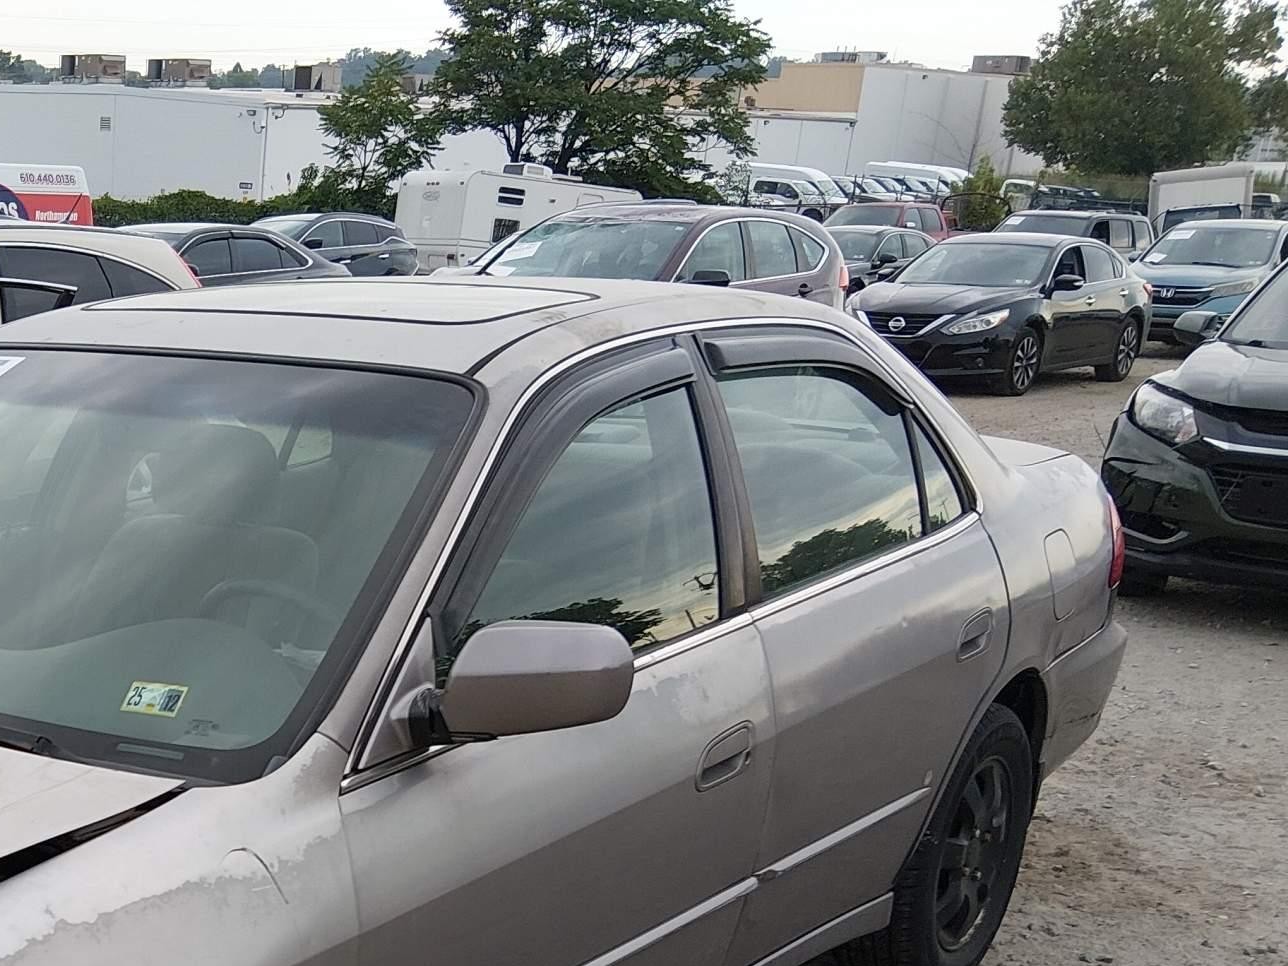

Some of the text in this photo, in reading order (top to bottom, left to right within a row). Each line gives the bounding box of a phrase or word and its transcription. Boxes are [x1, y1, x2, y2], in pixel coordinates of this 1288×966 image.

[19, 173, 76, 185] 610.440.0136
[127, 686, 146, 706] 25
[162, 694, 182, 713] 12
